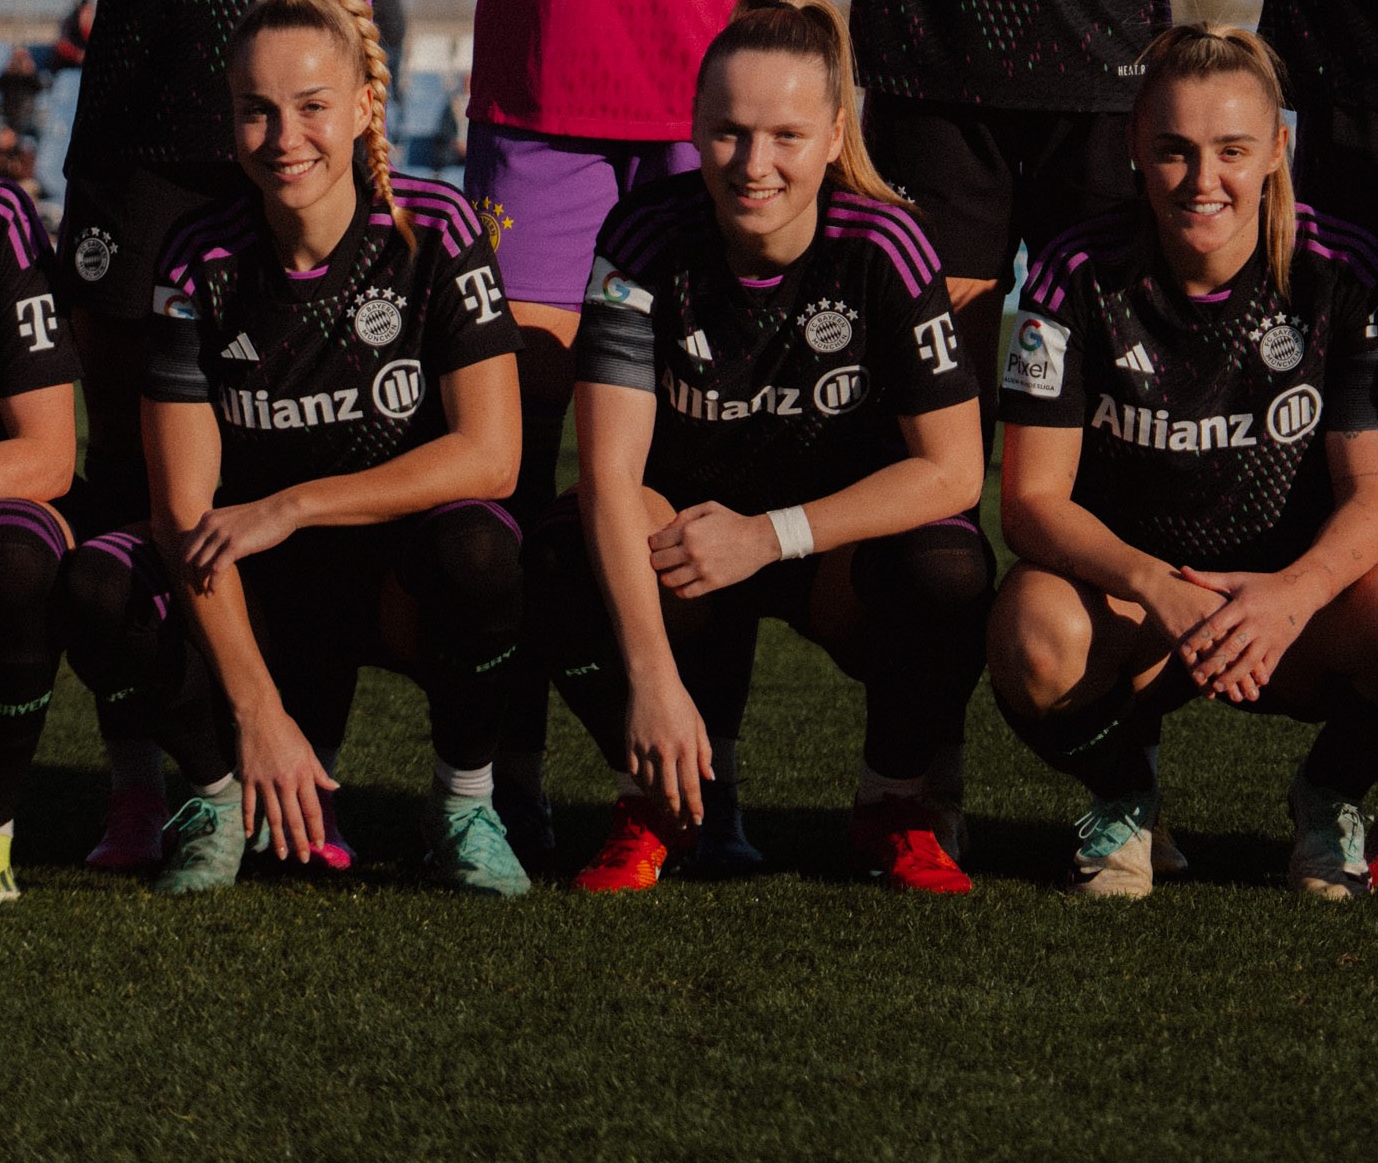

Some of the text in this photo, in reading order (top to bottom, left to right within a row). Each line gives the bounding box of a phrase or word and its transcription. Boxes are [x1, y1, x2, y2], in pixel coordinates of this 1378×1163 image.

[16, 293, 58, 353] T
[366, 303, 395, 317] BAYERN
[455, 265, 502, 325] T
[817, 315, 847, 330] BAYERN
[913, 311, 958, 376] T
[1007, 352, 1049, 380] Pixel
[660, 366, 803, 422] Allianz
[1090, 393, 1258, 452] Allianz
